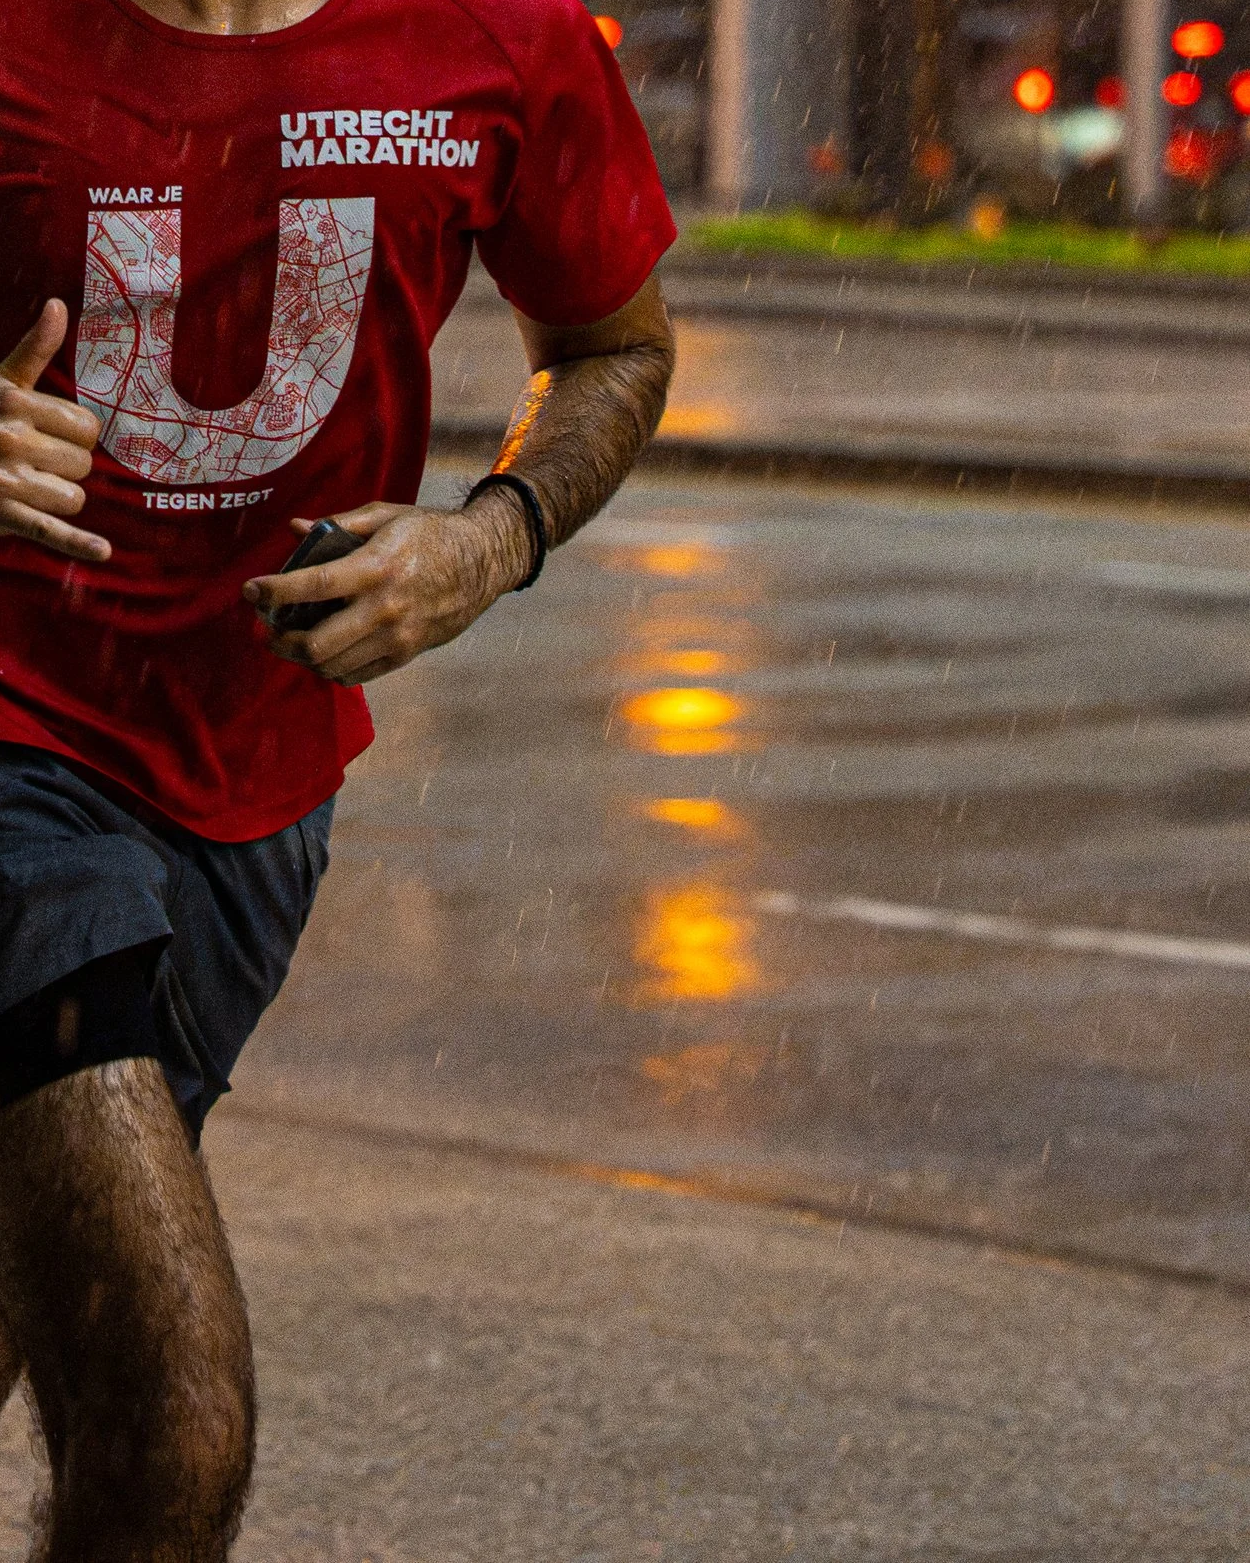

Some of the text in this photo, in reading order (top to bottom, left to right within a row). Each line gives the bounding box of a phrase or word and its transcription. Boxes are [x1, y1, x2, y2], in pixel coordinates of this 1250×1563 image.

[280, 109, 453, 139] UTRECHT
[281, 138, 480, 168] MARATHON
[88, 185, 183, 204] WAAR JE
[75, 197, 375, 484] U
[142, 488, 273, 510] TEGEN ZEGT
